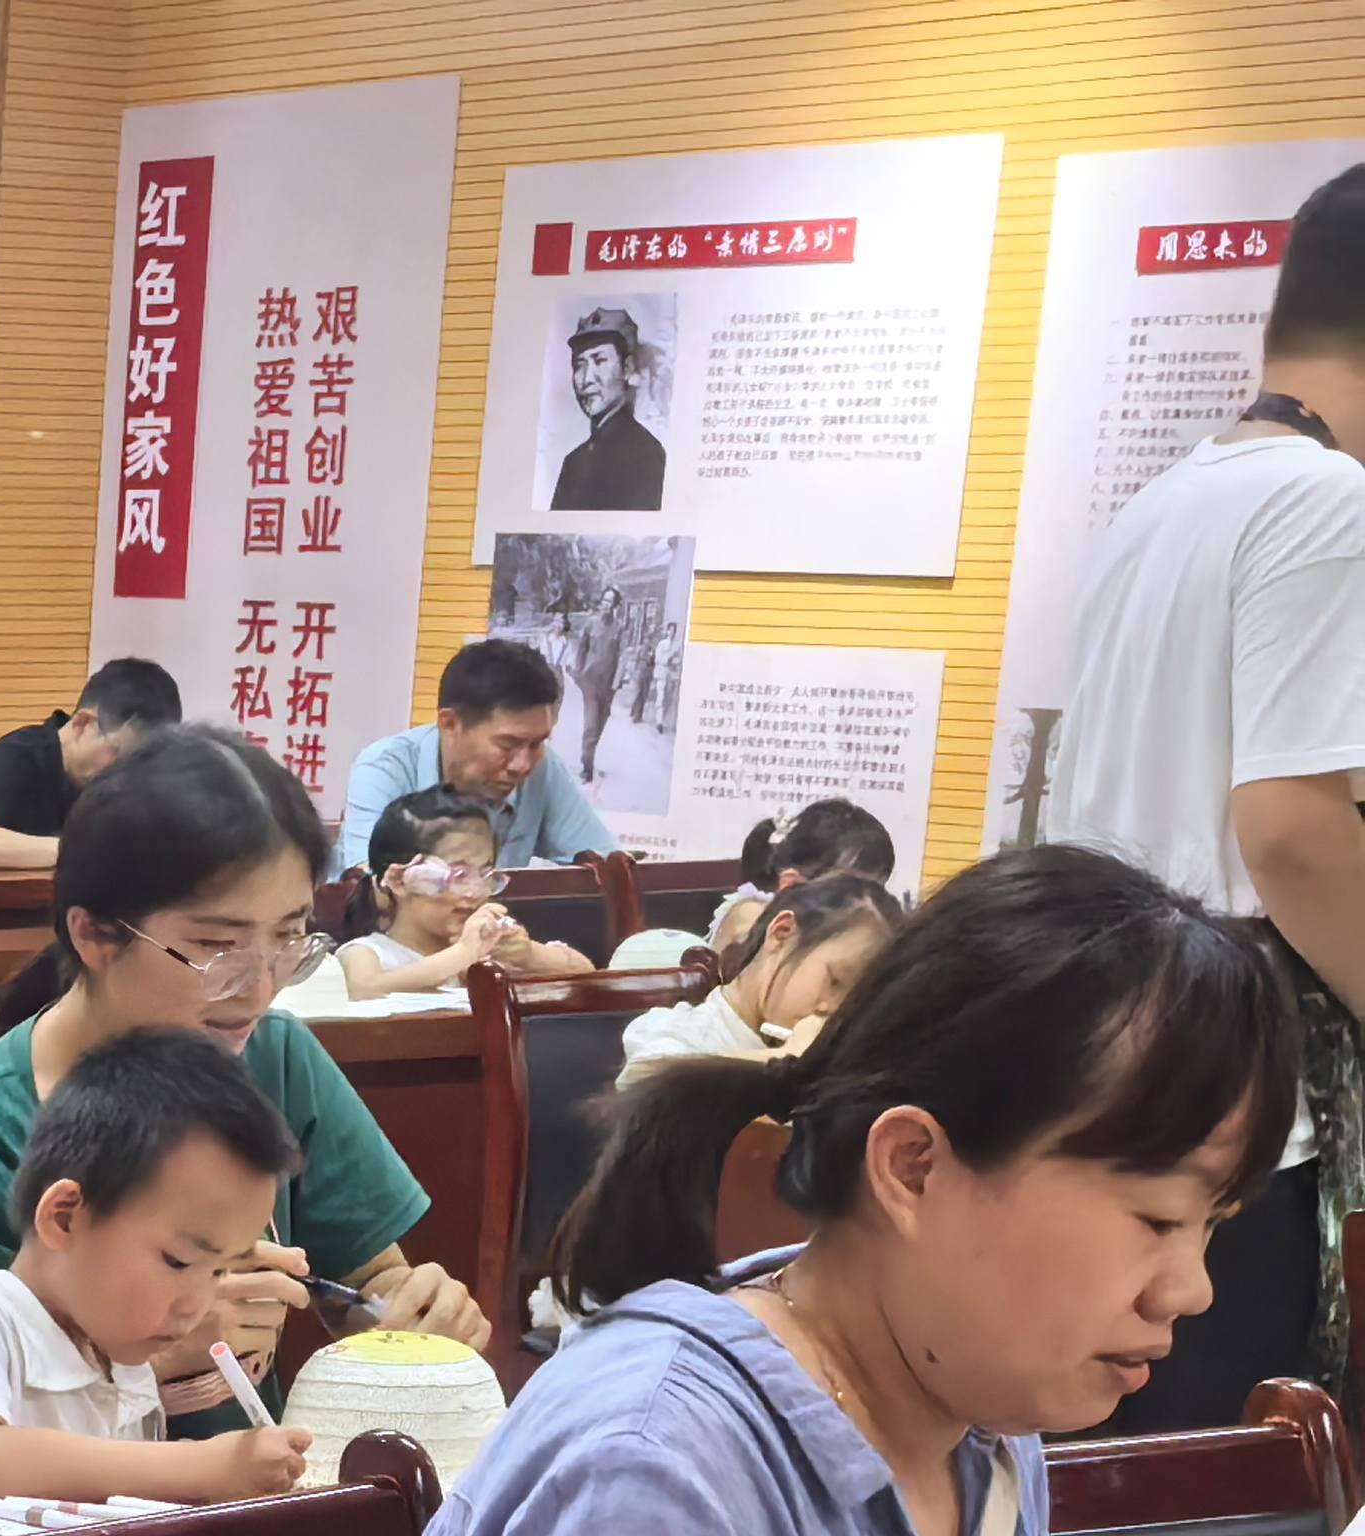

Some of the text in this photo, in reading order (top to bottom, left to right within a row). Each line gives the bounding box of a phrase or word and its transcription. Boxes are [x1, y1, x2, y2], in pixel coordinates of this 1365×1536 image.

[118, 181, 188, 555] 红色好家风
[230, 286, 300, 748] 热爱祖国 无私
[298, 285, 360, 554] 艰苦创业
